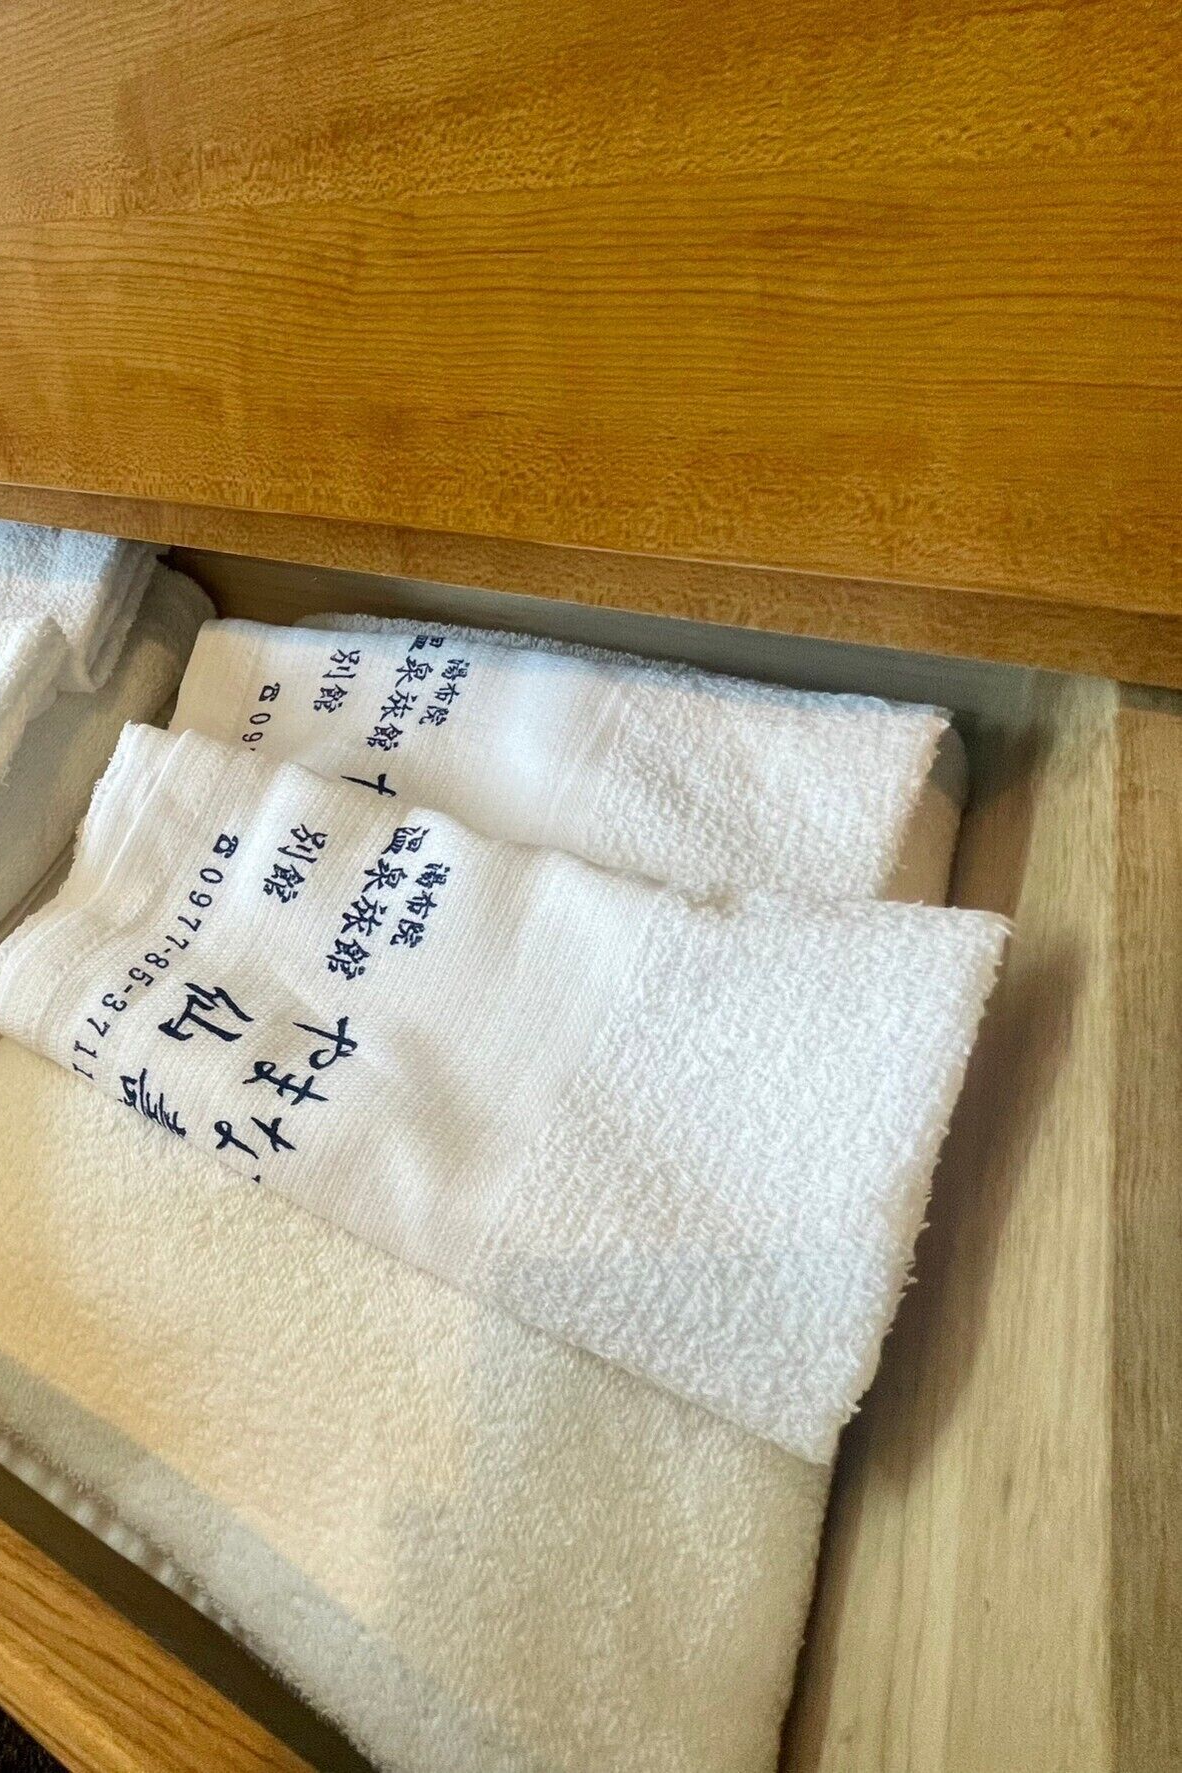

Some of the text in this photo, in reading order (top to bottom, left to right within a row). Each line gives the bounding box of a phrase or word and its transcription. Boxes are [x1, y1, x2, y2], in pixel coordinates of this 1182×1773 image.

[313, 648, 362, 714] 別館
[419, 658, 471, 727] 湯布院
[262, 823, 329, 904] 別館
[325, 825, 431, 981] 温泉旅館
[389, 862, 452, 949] 湯布院
